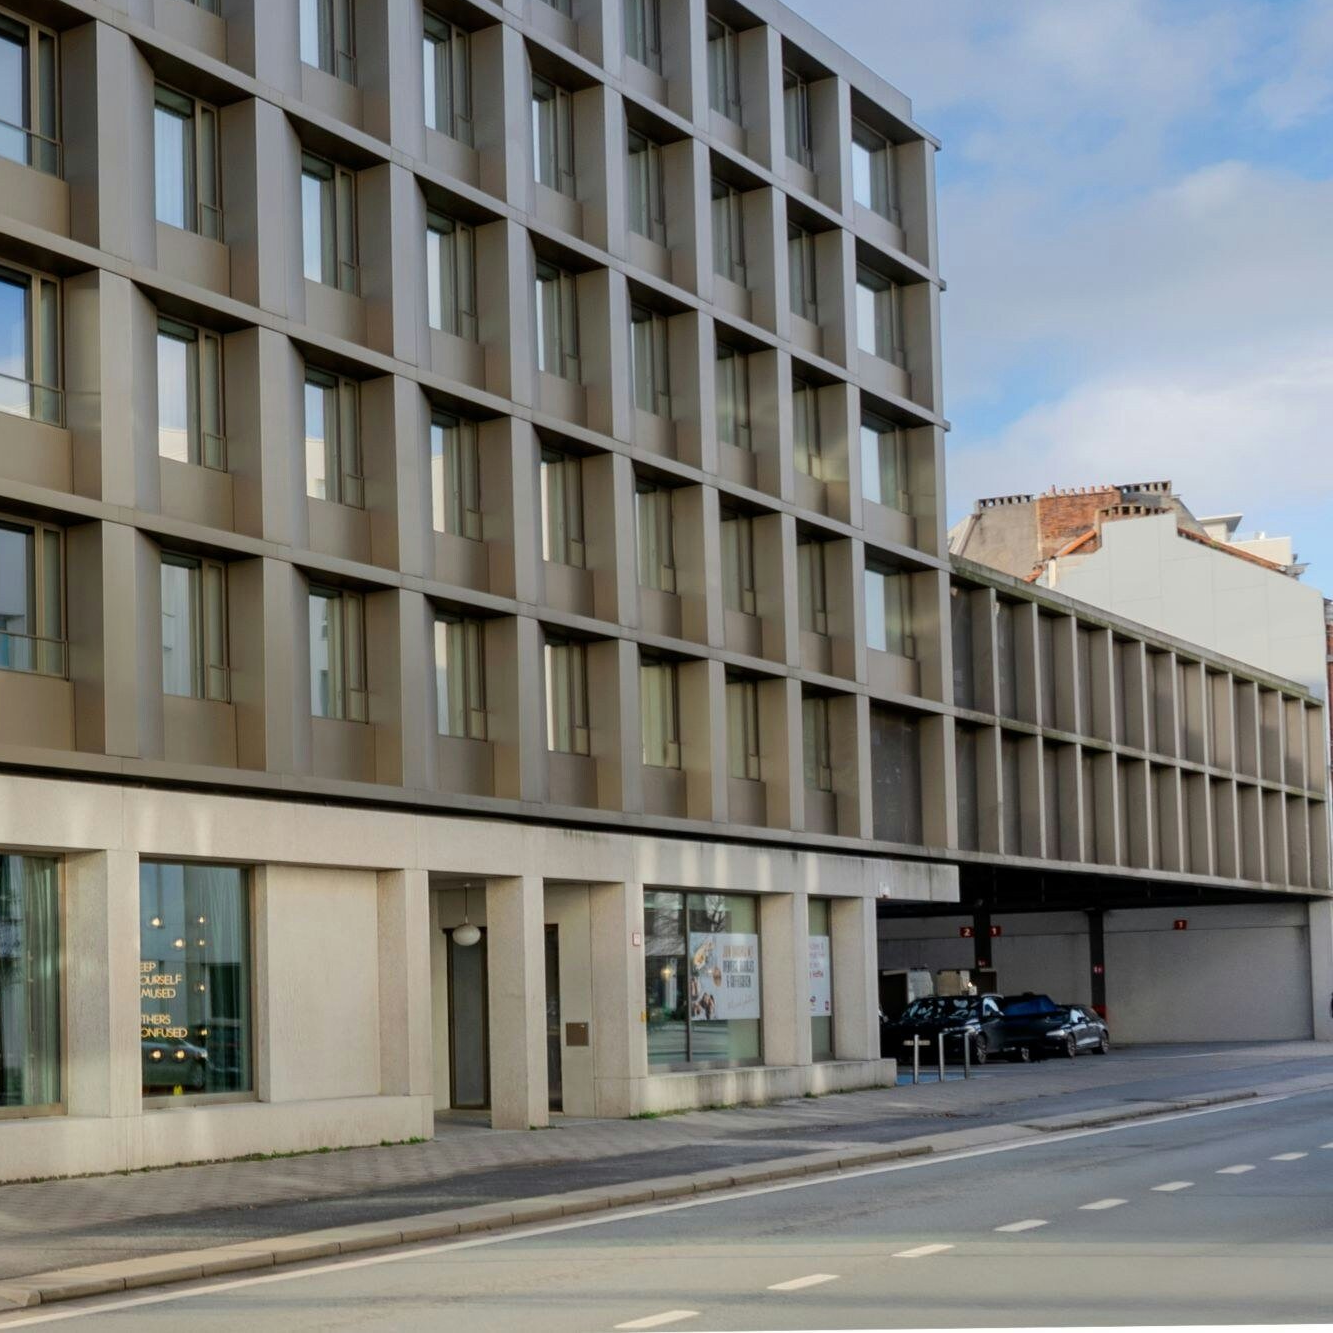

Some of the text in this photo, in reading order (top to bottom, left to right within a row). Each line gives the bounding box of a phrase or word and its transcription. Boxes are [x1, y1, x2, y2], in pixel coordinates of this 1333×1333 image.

[140, 962, 156, 972] EEP
[140, 974, 182, 985] OURSELF
[140, 988, 177, 998] MUSED
[140, 1014, 171, 1025] THERS
[140, 1027, 188, 1038] ONFUSED
